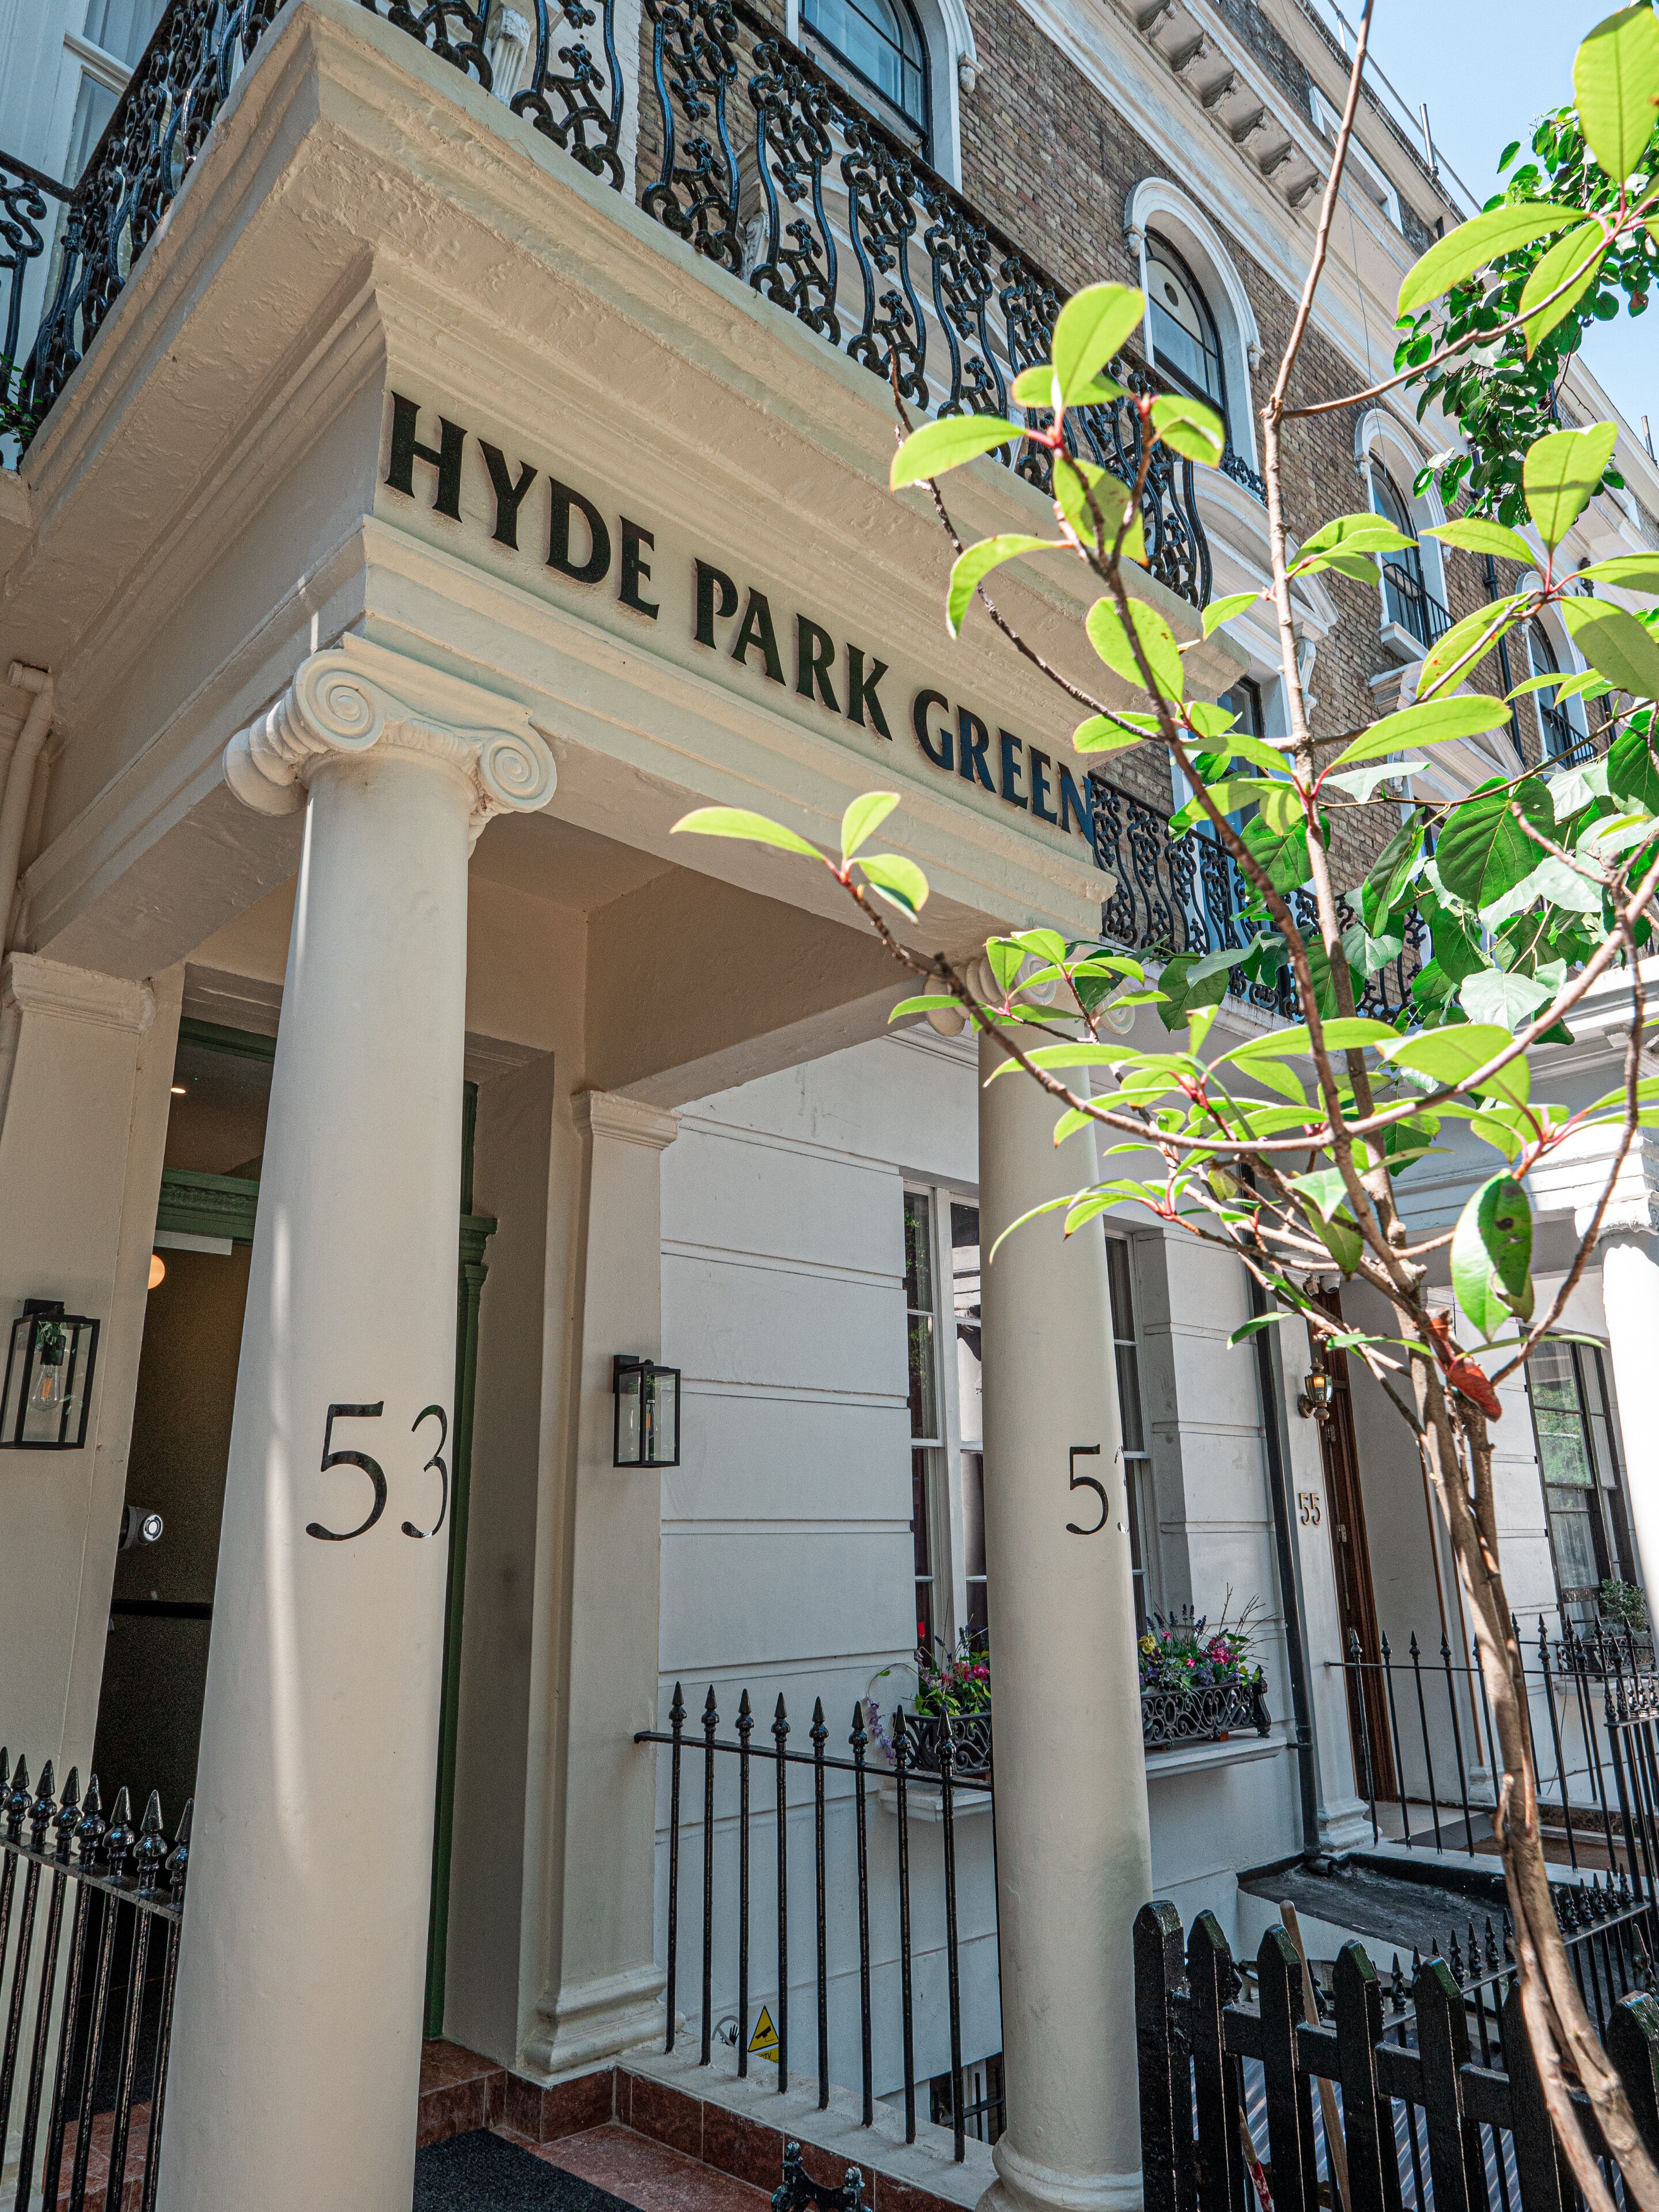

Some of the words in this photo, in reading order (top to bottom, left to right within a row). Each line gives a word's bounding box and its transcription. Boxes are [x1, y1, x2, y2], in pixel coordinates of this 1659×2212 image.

[384, 391, 660, 620] HYDE
[693, 556, 893, 742] PARK
[913, 688, 1094, 847] GREEN
[305, 1400, 448, 1541] 53
[1298, 1493, 1322, 1526] 55
